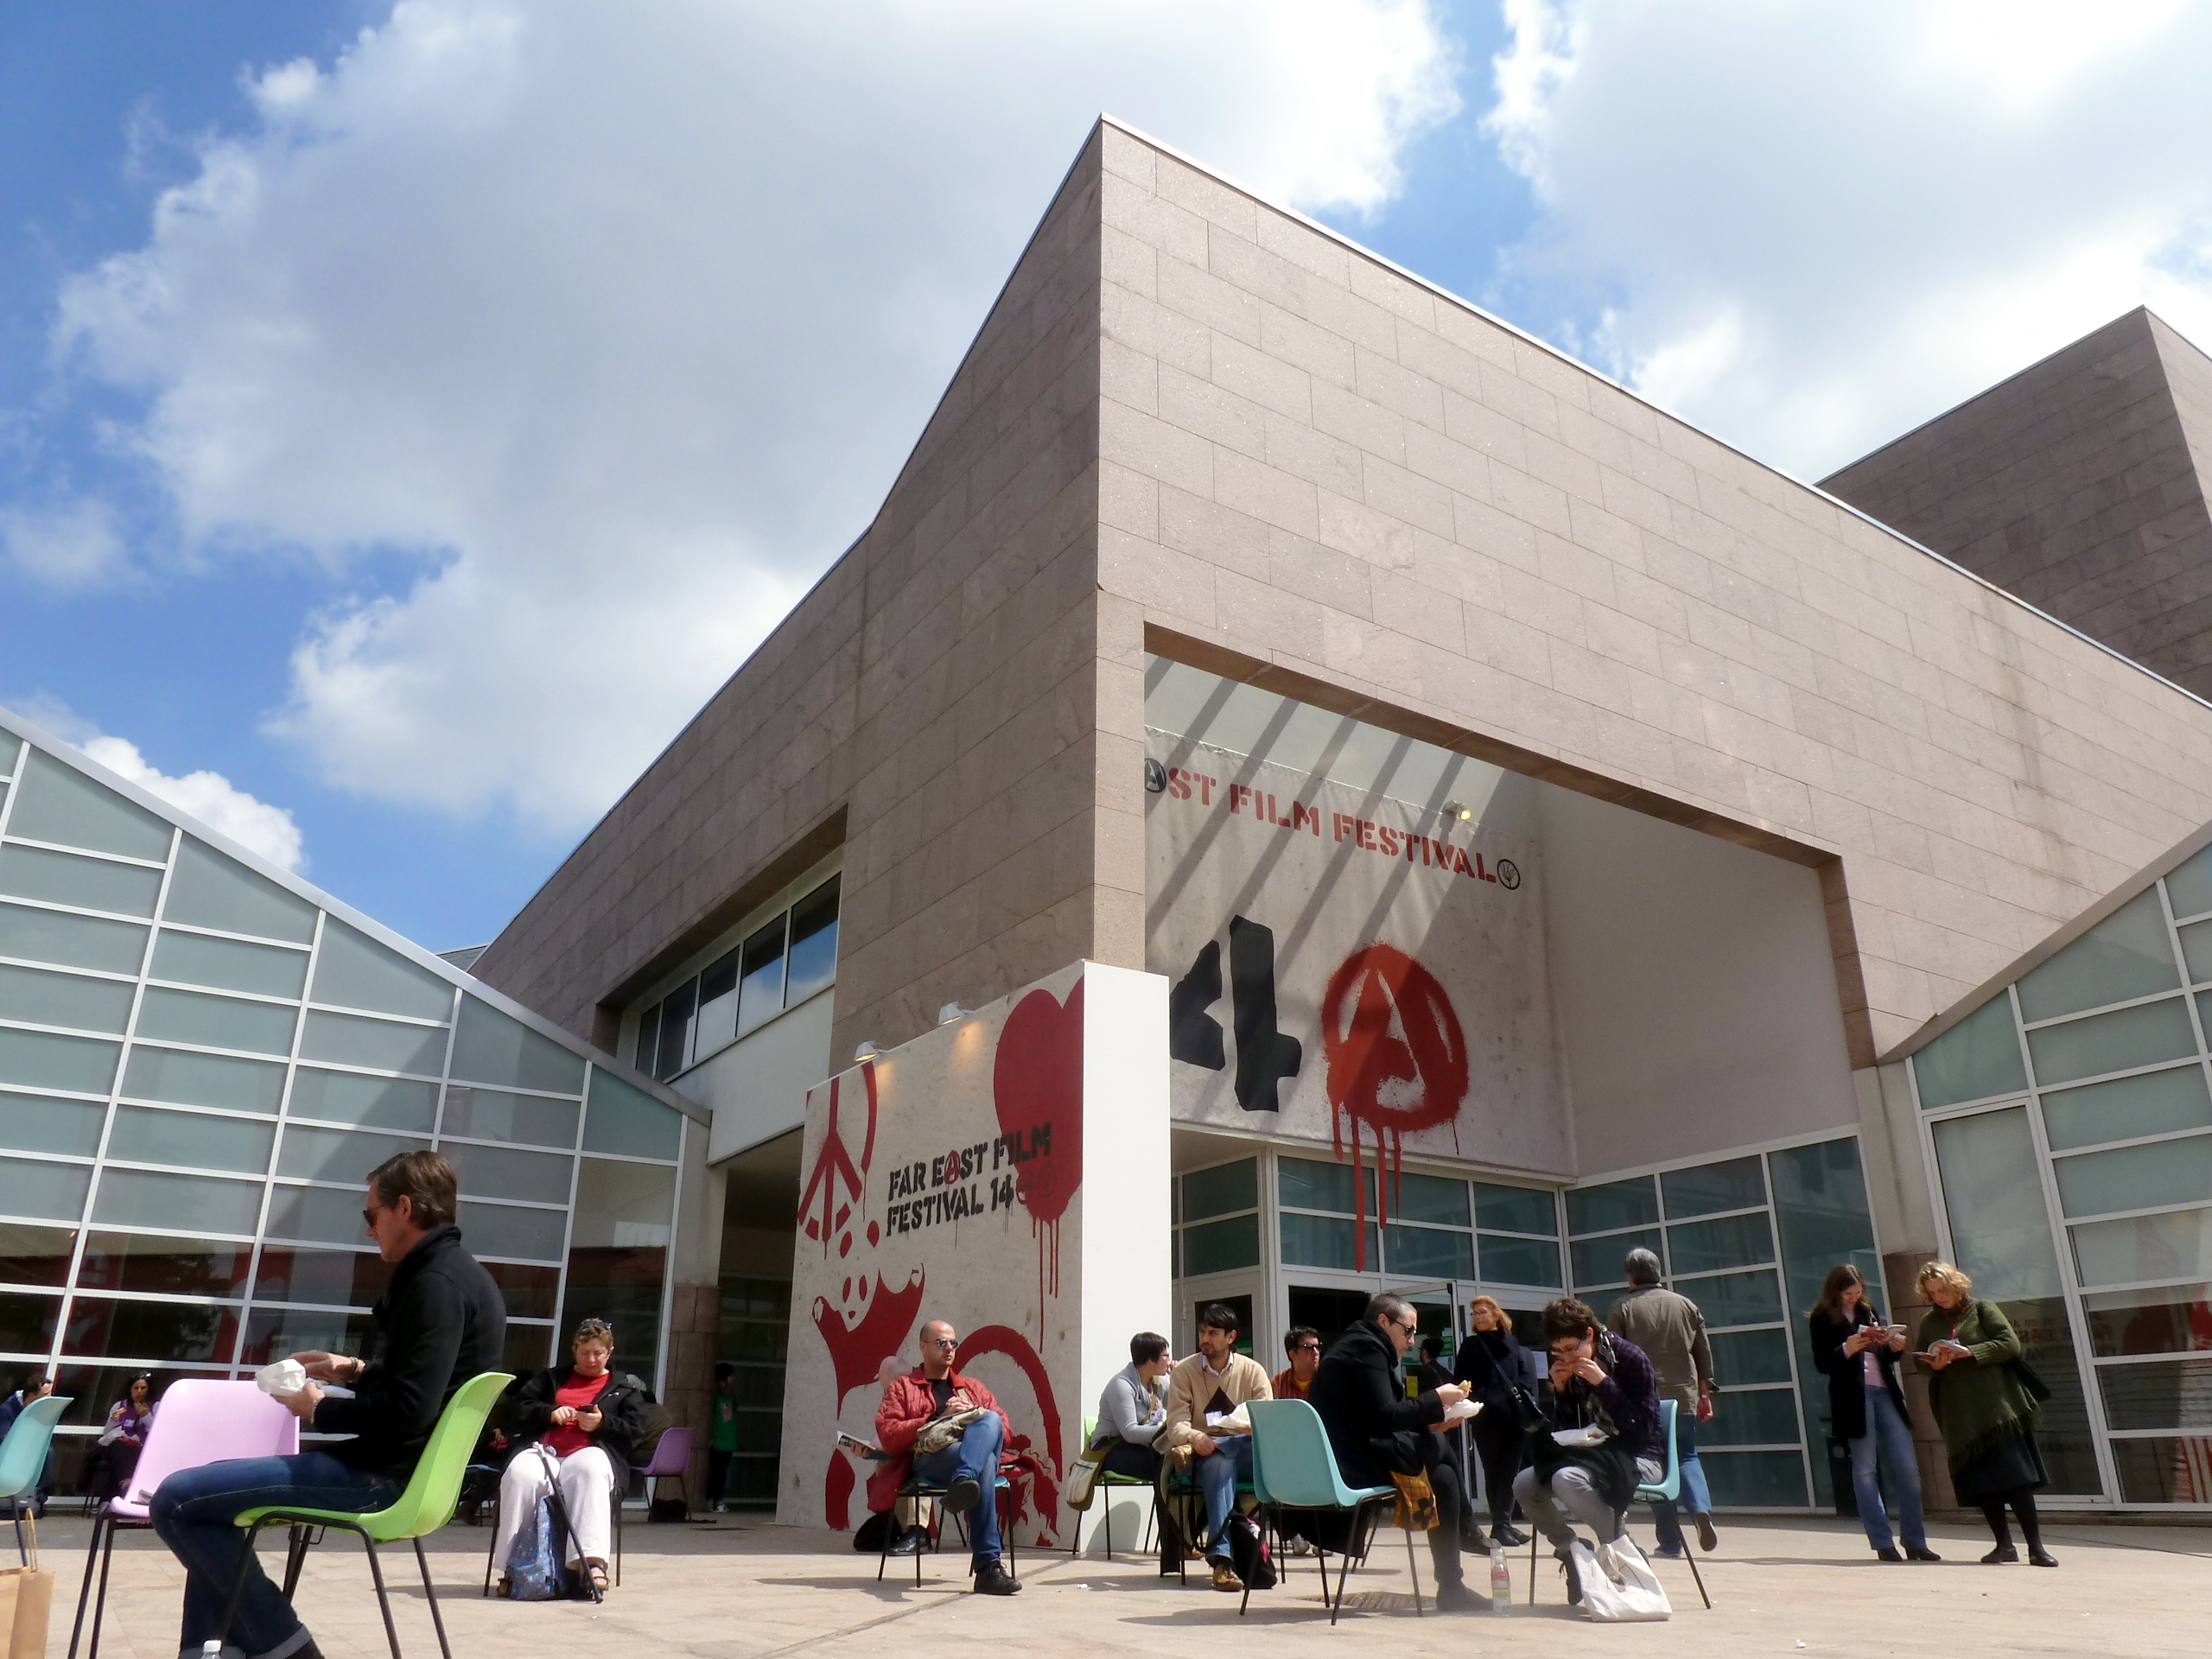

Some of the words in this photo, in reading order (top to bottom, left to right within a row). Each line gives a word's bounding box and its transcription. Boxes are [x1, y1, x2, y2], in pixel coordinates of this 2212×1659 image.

[1230, 783, 1319, 836] FILM
[1333, 812, 1497, 883] FESTIVAL
[888, 1161, 926, 1202] FAR
[931, 1141, 988, 1188] EAST
[993, 1121, 1052, 1171] FILM
[886, 1183, 985, 1237] FESTIVAL
[990, 1173, 1014, 1211] 14
